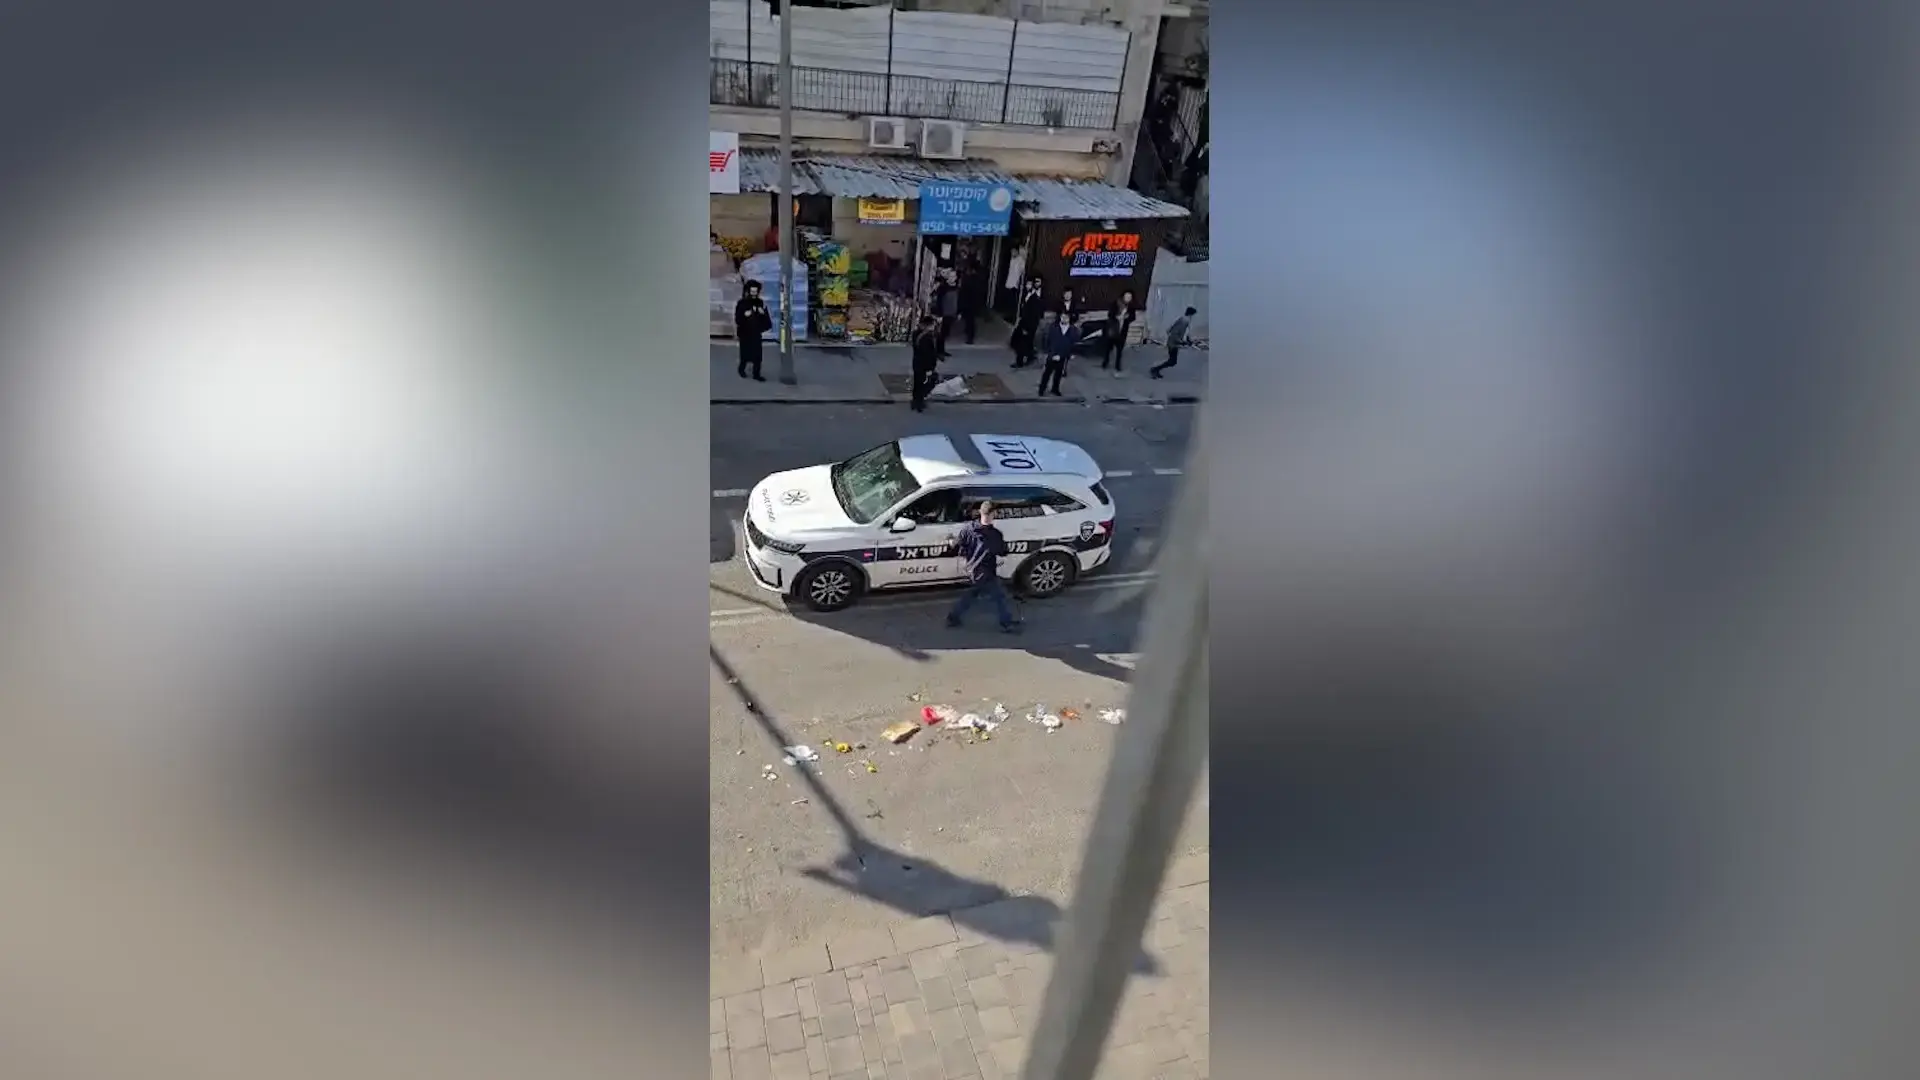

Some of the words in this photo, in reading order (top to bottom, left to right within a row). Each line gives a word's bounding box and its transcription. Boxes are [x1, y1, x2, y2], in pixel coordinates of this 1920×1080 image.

[938, 201, 970, 214] טונר
[1073, 251, 1137, 267] תקשורת
[986, 441, 1036, 469] 011
[896, 545, 949, 559] ישראל
[900, 565, 939, 574] POLICE
